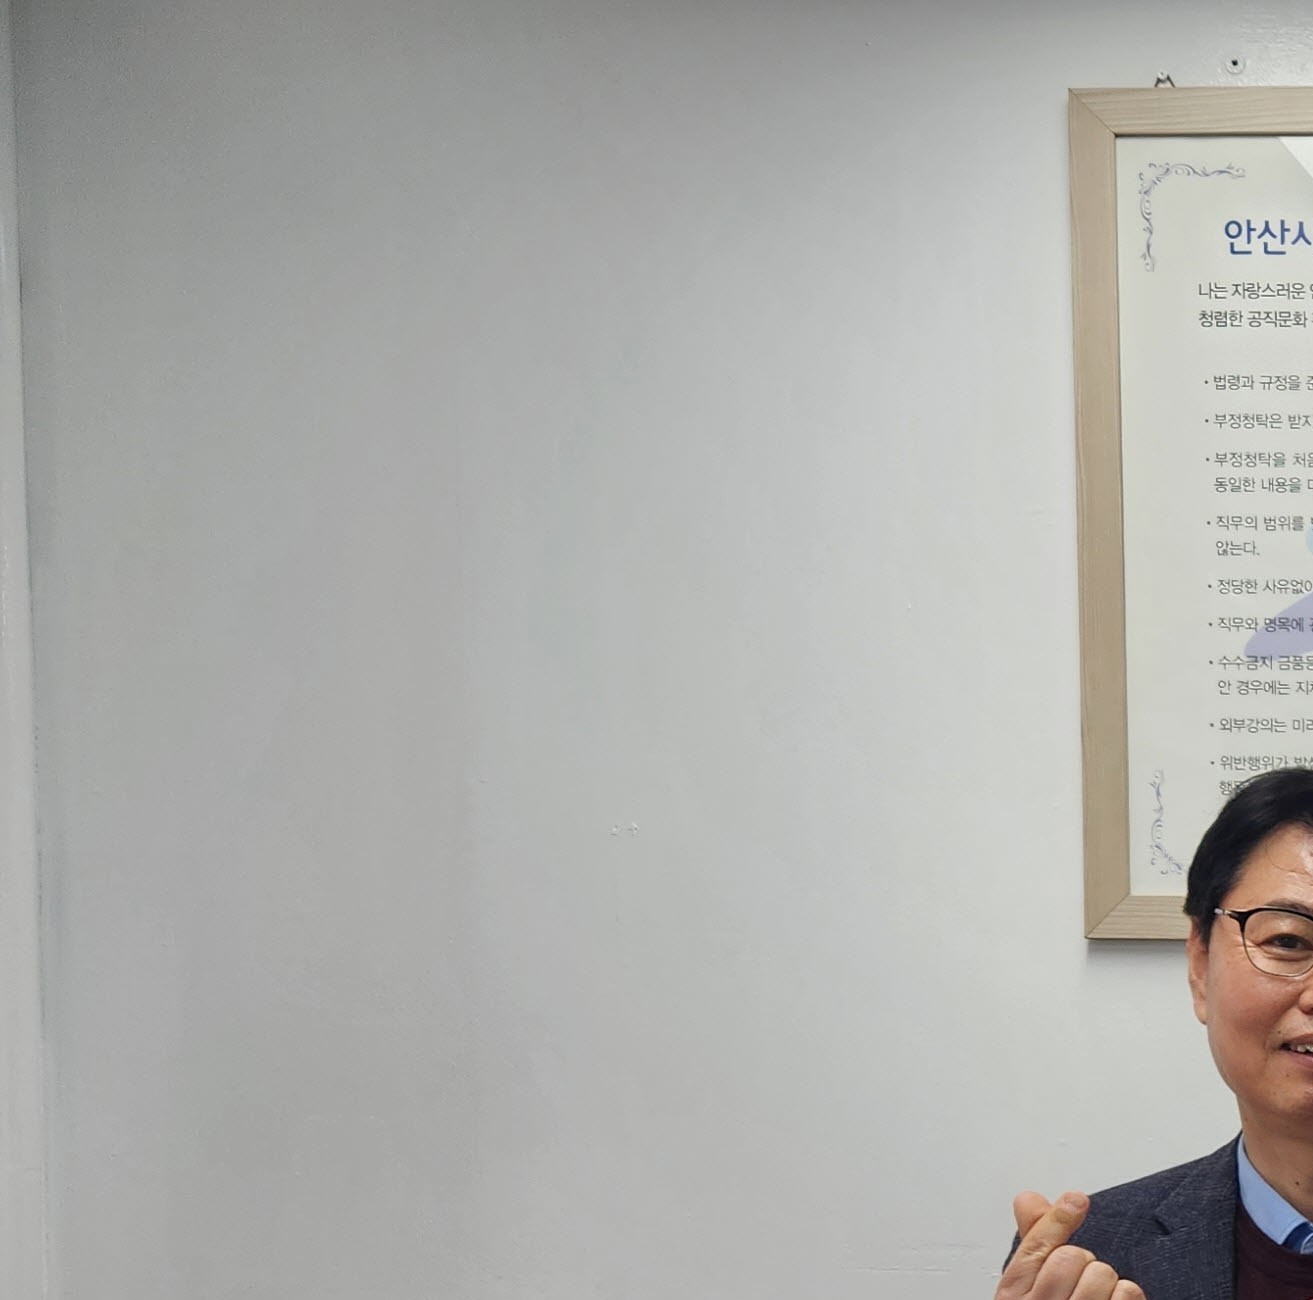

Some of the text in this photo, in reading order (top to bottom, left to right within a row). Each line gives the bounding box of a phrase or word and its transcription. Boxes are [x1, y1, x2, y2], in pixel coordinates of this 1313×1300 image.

[1198, 282, 1228, 300] 나는
[1231, 282, 1306, 300] 자랑스러운
[1198, 310, 1243, 329] 청렴한
[1247, 310, 1307, 329] 공직문화
[1213, 374, 1254, 392] 법령과
[1259, 374, 1301, 392] 규정을
[1214, 414, 1282, 430] 부정청탁은
[1214, 452, 1285, 469] 부정청탁을
[1214, 477, 1255, 494] 동일한
[1261, 477, 1301, 494] 내용을
[1216, 515, 1257, 532] 직무의
[1263, 515, 1304, 532] 범위를
[1216, 540, 1260, 556] 않는다.
[1218, 579, 1258, 596] 정당한
[1218, 617, 1258, 635] 직무와
[1264, 617, 1304, 635] 명목에
[1218, 655, 1273, 672] 수수금지
[1218, 681, 1231, 697] 안
[1236, 681, 1290, 697] 경우에는
[1220, 718, 1287, 734] 외부강의는
